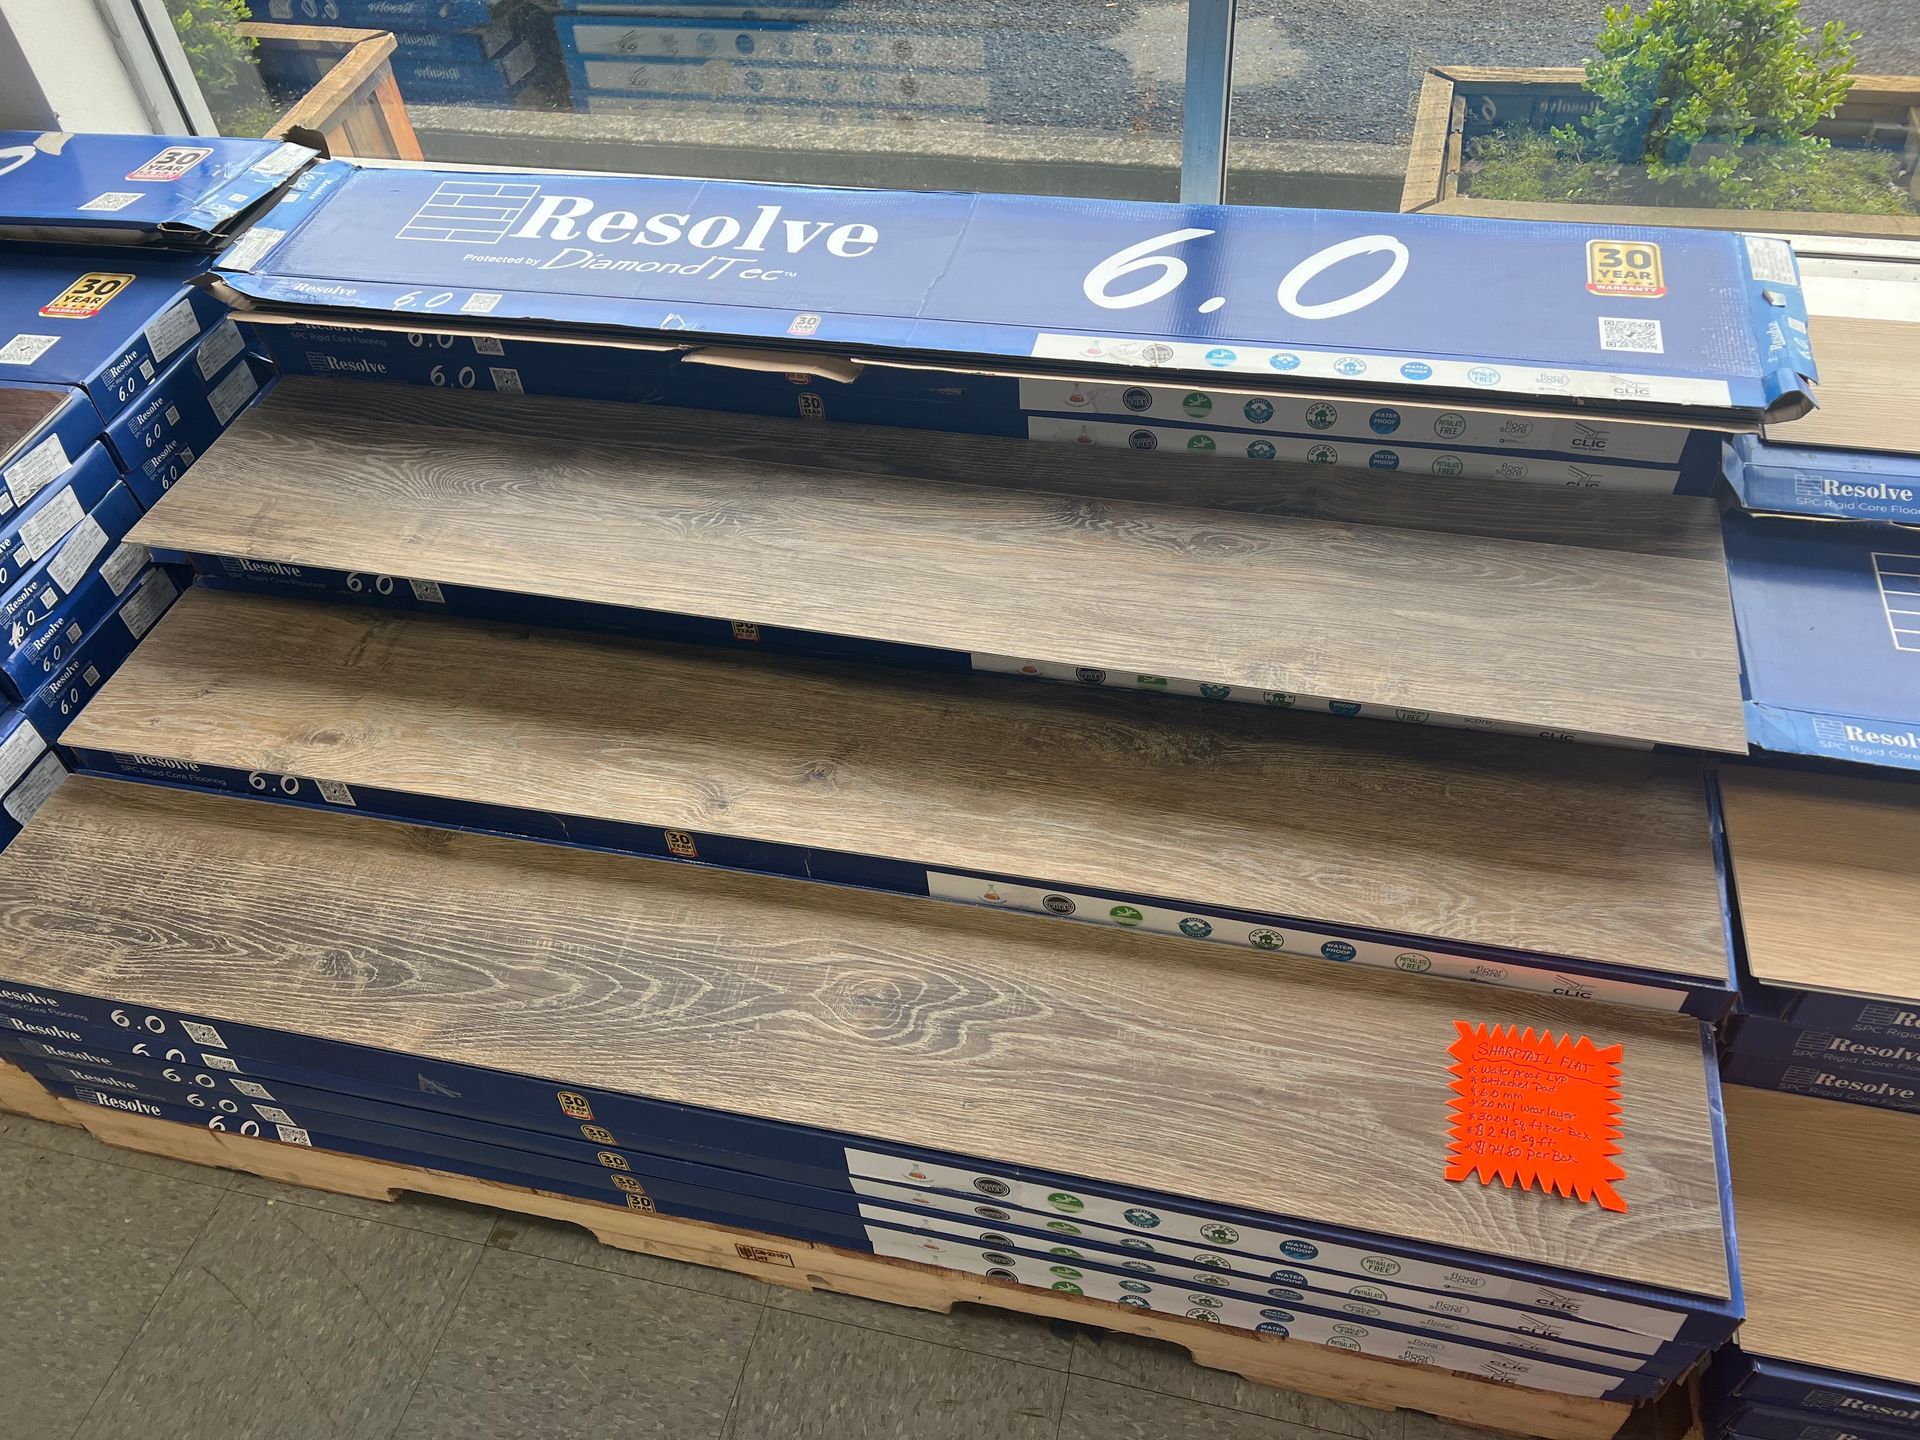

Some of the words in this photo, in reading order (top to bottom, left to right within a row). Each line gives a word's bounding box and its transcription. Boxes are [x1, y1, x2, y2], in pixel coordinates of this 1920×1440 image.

[510, 195, 878, 257] Resolve
[463, 254, 521, 264] Protected
[526, 258, 541, 266] by
[1598, 248, 1652, 269] 30
[1083, 228, 1409, 319] 6.0
[1598, 269, 1652, 280] YEAR
[71, 279, 122, 296] 30
[292, 282, 358, 296] Resolve
[1597, 284, 1658, 293] WARRANTY
[64, 296, 102, 304] YEAR
[394, 291, 453, 309] 6.0
[797, 316, 818, 326] 30
[110, 350, 138, 378] Resolve
[326, 356, 387, 374] Resolve
[430, 365, 476, 389] 6.0
[118, 377, 135, 402] 6.0
[1613, 387, 1650, 396] CLIC
[802, 397, 820, 409] 30
[136, 397, 164, 425] Resolve
[145, 423, 161, 448] 6.0
[1440, 427, 1458, 436] FREE
[1572, 438, 1607, 449] CLIC
[151, 439, 177, 467] Resolve
[1373, 459, 1395, 467] PROOF
[162, 465, 178, 490] 6.0
[1823, 479, 1914, 502] Resolve
[1796, 497, 1822, 506] SPC
[1824, 500, 1855, 510] Rigid
[1858, 502, 1888, 513] Core
[239, 559, 302, 578] Resolve
[347, 571, 394, 596] 6.0
[7, 581, 38, 615] Resolve
[33, 618, 64, 650] Resolve
[43, 645, 61, 671] 6.0
[50, 660, 79, 693] Resolve
[60, 688, 79, 715] 6.0
[1402, 714, 1421, 722] FREE
[1539, 731, 1576, 742] CLIC
[1818, 740, 1848, 751] SPC
[1850, 745, 1885, 757] Rigid
[166, 770, 187, 779] Core
[249, 770, 299, 795] 6.0
[669, 832, 690, 845] 30
[1325, 948, 1352, 956] PROOF
[1326, 943, 1353, 951] WATER
[1401, 963, 1422, 971] FREE
[1477, 965, 1503, 976] floor
[1553, 987, 1592, 999] CLIC
[110, 1009, 166, 1034] 6.0
[1852, 1023, 1884, 1034] SPC
[11, 1017, 82, 1041] Resolve
[1478, 1042, 1553, 1065] SHARPTAIL
[1560, 1056, 1596, 1073] FLAT
[1792, 1049, 1821, 1059] SPC
[1823, 1053, 1858, 1065] Rigid
[1862, 1059, 1894, 1069] Core
[42, 1044, 113, 1065] Resolve
[162, 1068, 216, 1088] 6.0
[1547, 1074, 1568, 1085] LVP
[1814, 1072, 1915, 1099] Resolve
[71, 1069, 138, 1090] Resolve
[187, 1093, 238, 1113] 6.0
[1503, 1092, 1524, 1100] mm
[95, 1092, 162, 1117] Resolve
[561, 1095, 586, 1108] 30
[566, 1104, 587, 1113] YEAR
[1481, 1100, 1495, 1109] 20
[1497, 1101, 1516, 1111] mil
[1547, 1106, 1577, 1123] layer
[586, 1127, 609, 1139] 30
[1545, 1124, 1564, 1136] per
[1568, 1127, 1592, 1141] Box
[603, 1154, 624, 1166] 30
[1527, 1149, 1549, 1162] per
[1552, 1151, 1579, 1164] Box
[617, 1176, 637, 1187] 30
[630, 1196, 651, 1208] 30
[1218, 1224, 1236, 1238] FREE
[1285, 1245, 1313, 1254] PROOF
[1286, 1241, 1315, 1251] WATER
[1368, 1264, 1391, 1274] FREE
[1276, 1272, 1304, 1281] WATER
[1536, 1298, 1582, 1312] CLIC
[1260, 1324, 1286, 1333] WATER
